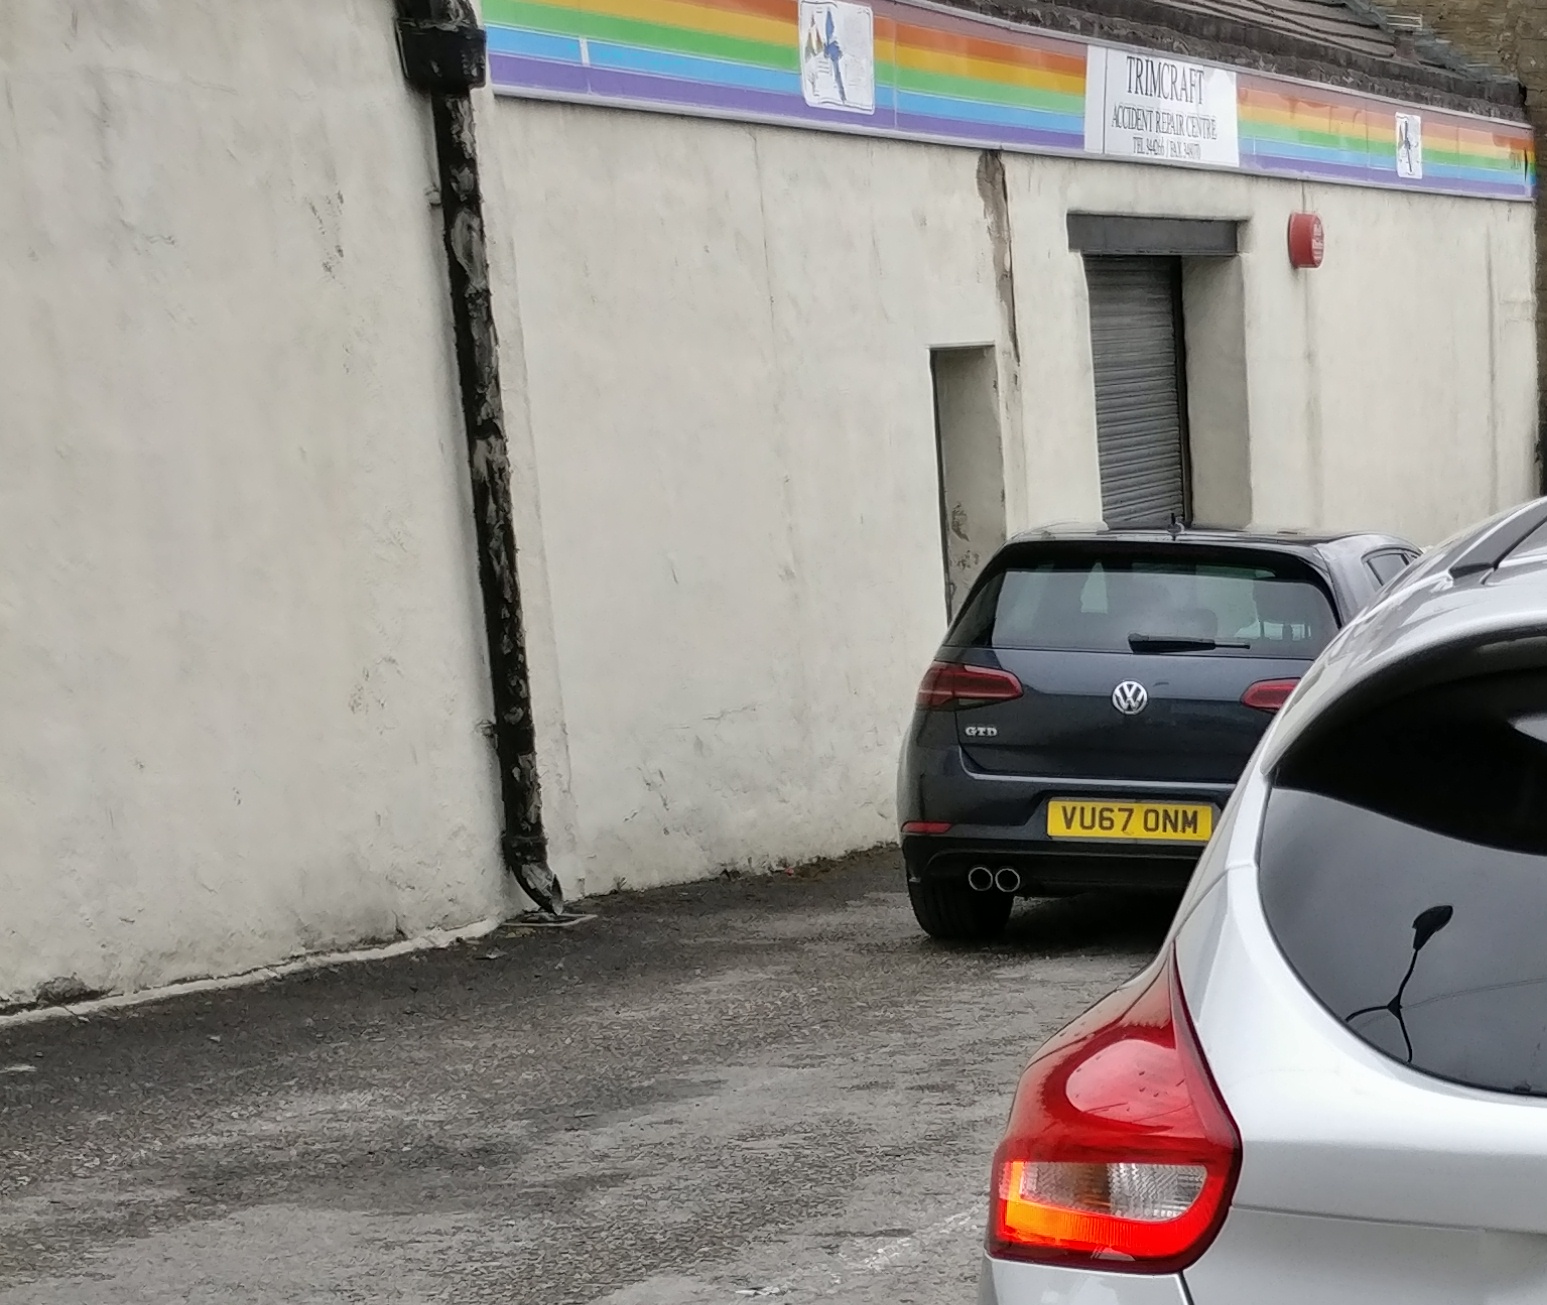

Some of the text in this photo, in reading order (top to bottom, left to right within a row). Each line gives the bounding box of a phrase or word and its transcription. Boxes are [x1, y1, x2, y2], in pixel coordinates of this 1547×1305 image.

[1126, 55, 1205, 105] TRIMCRAFT
[1112, 103, 1218, 140] ACCIDENT REPAIR CENTRE
[965, 726, 998, 737] GTD
[1061, 806, 1198, 834] VU67 ONM
